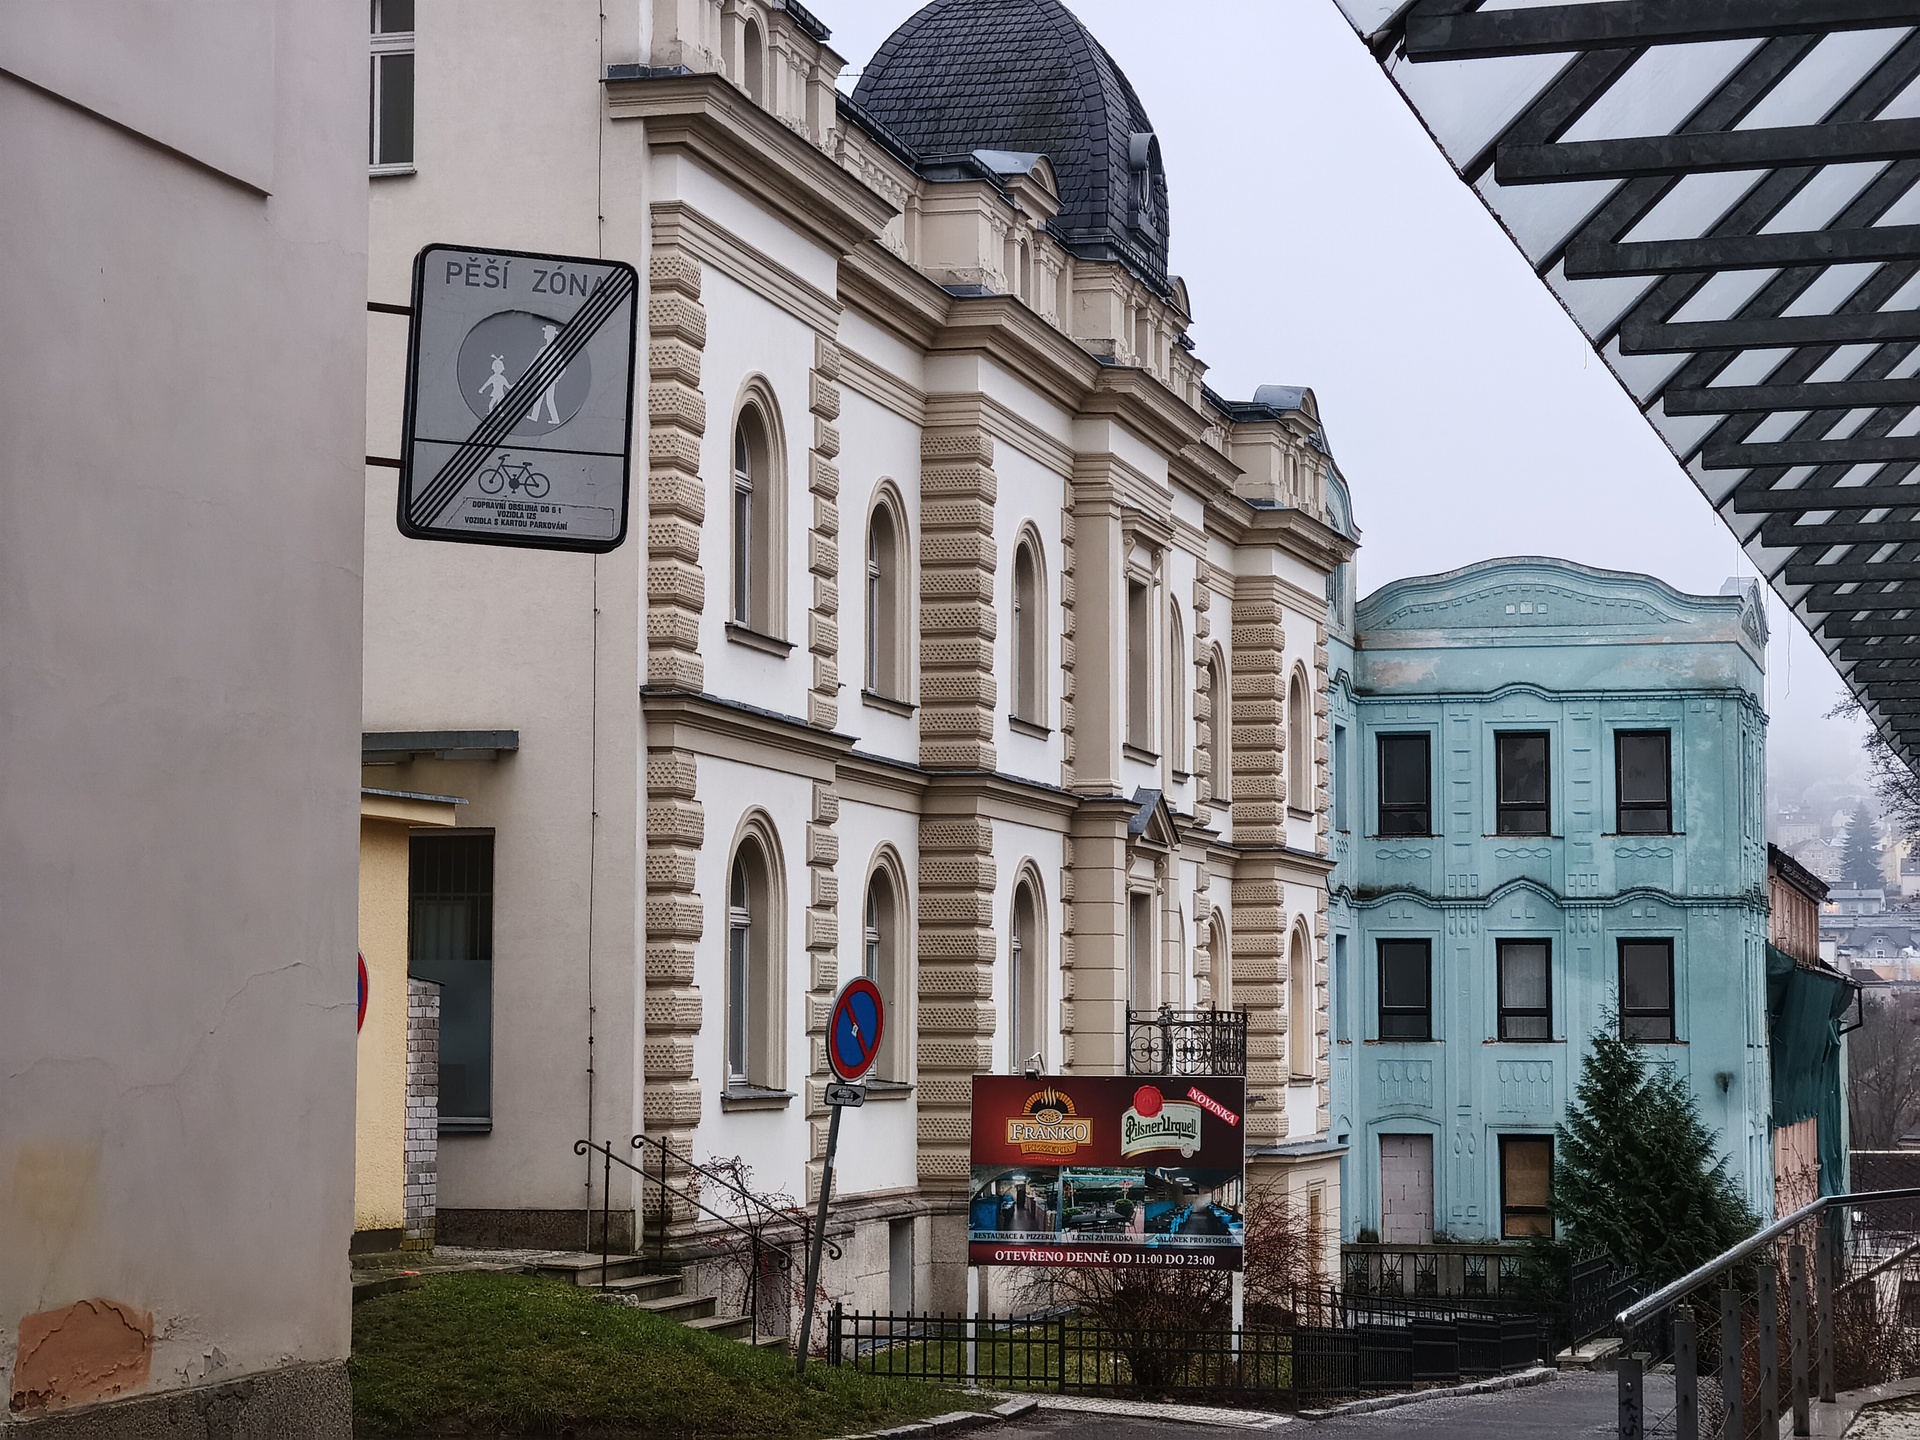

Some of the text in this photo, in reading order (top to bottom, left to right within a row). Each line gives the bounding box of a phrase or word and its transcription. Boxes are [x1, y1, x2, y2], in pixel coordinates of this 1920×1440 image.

[445, 256, 511, 290] PĚŠÍ
[472, 500, 506, 510] DOPRAVNÍ
[508, 503, 538, 512] OBSLUHA
[540, 505, 550, 513] DO
[497, 510, 537, 520] VOZIDLA IZS
[464, 516, 492, 525] VOZIDLA
[500, 518, 527, 527] KARTOU
[529, 520, 568, 530] PARKOVÁNÍ
[1189, 1089, 1236, 1124] NOVINKA
[1125, 1114, 1198, 1145] Pilsner Urquell
[973, 1232, 1018, 1240] RESTAURACE
[1026, 1233, 1057, 1241] PIZZERIA
[1072, 1234, 1094, 1242] LETNÍ
[1212, 1237, 1233, 1245] OSOB
[995, 1249, 1216, 1266] OTEVŘENO DENNĚ OD 11:00 DO 23:00
